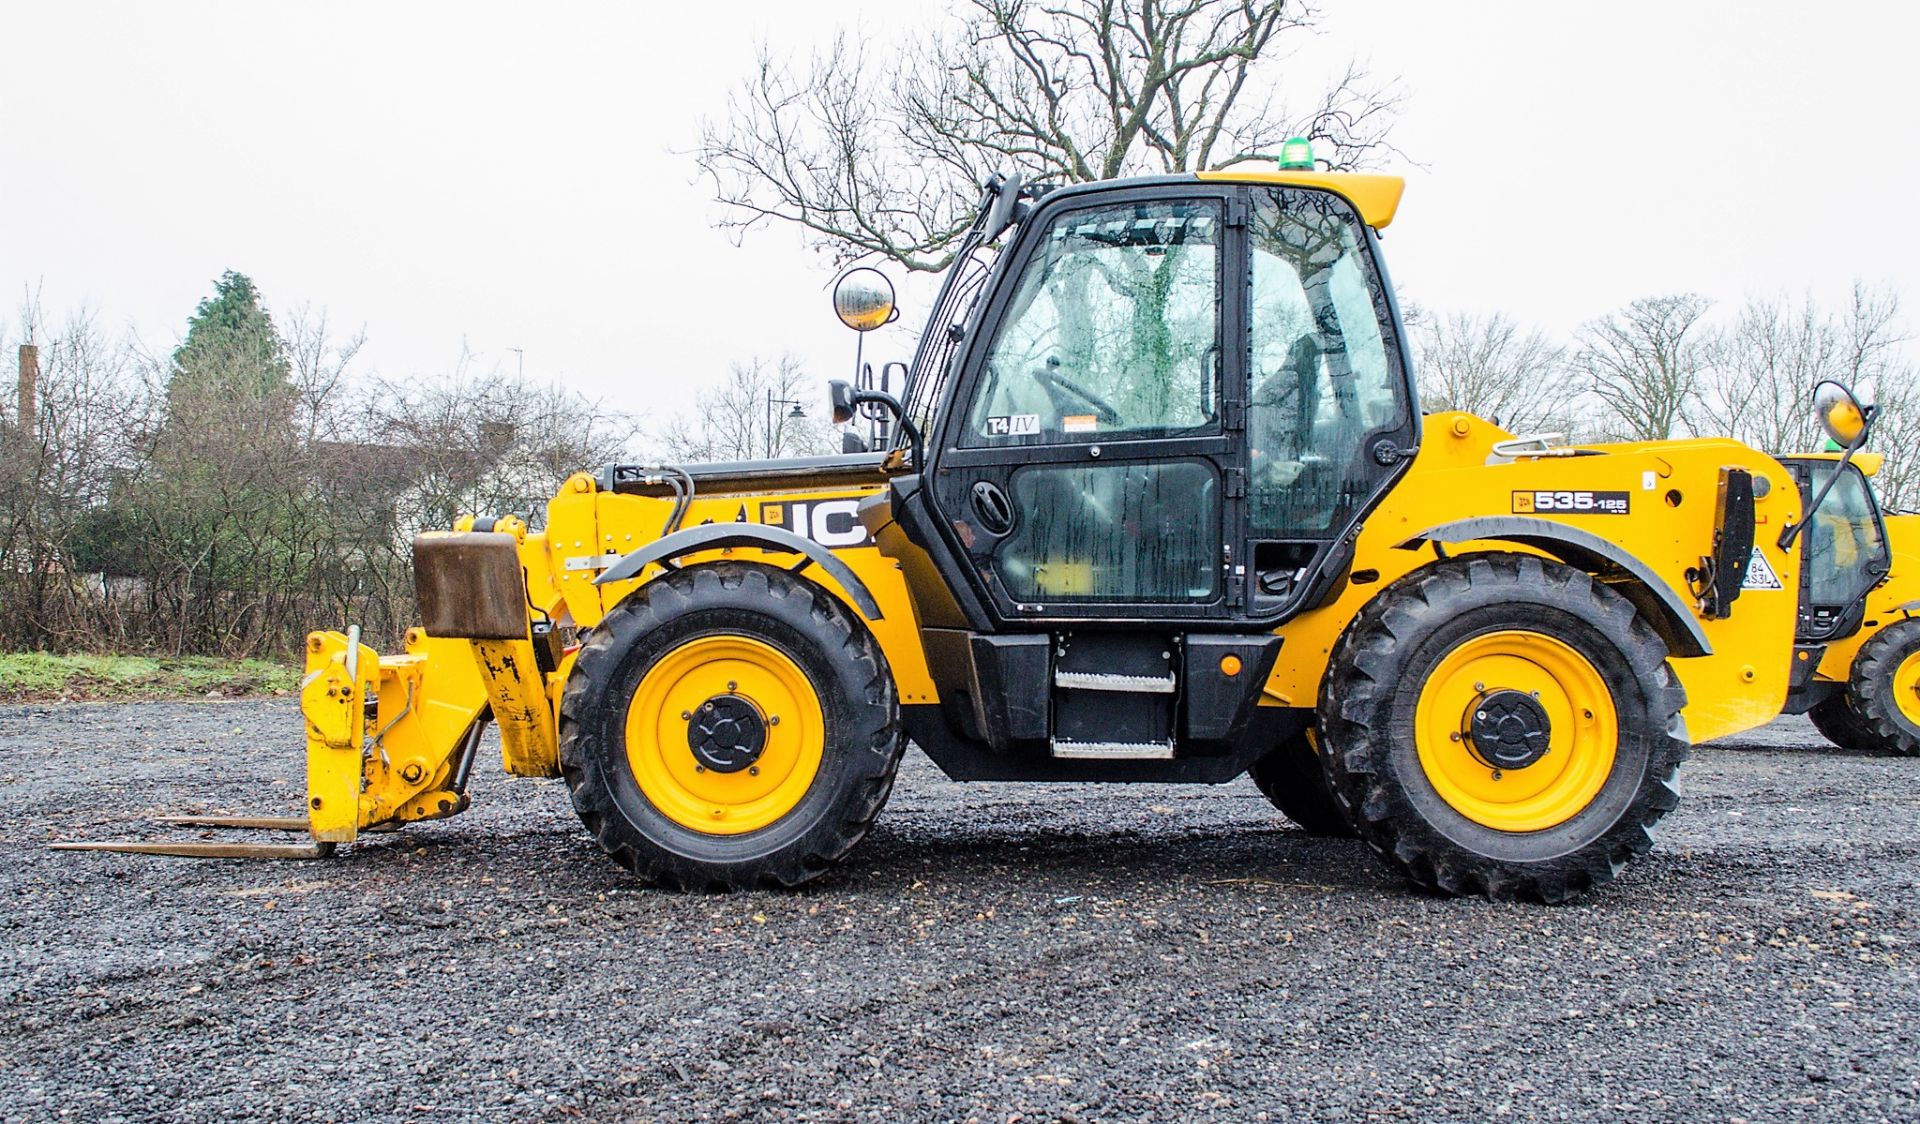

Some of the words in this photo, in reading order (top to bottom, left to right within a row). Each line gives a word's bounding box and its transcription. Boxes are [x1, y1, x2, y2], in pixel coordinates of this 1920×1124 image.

[988, 417, 1009, 434] T4
[1014, 416, 1035, 432] IV
[1534, 491, 1627, 509] 535-125
[1751, 563, 1763, 573] 84
